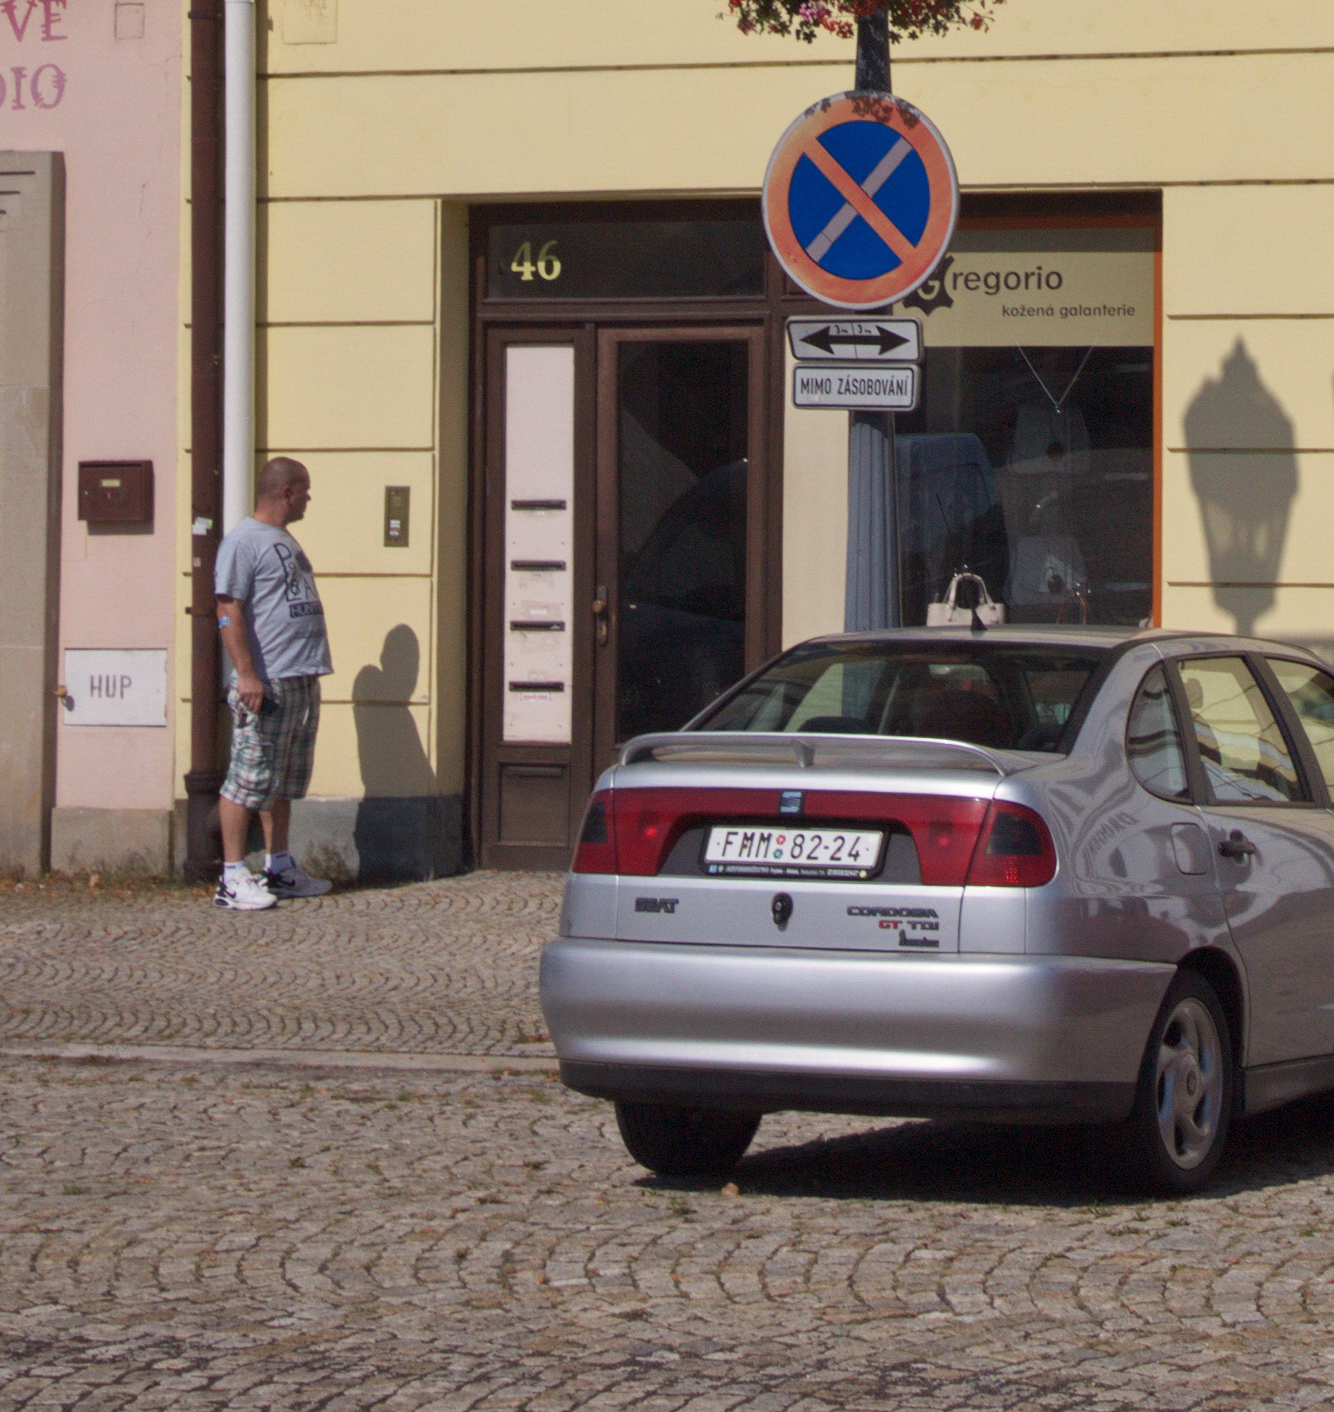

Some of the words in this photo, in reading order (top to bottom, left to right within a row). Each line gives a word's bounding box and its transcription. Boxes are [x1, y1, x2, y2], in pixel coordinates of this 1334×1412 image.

[0, 63, 67, 110] IO
[511, 240, 562, 280] 46
[1002, 304, 1054, 317] kožená
[1060, 304, 1135, 318] galanterie
[801, 378, 831, 395] MIMO
[838, 374, 909, 396] ZÁSOBOVÁNÍ
[90, 675, 132, 699] HUP
[722, 831, 772, 859] FMM
[790, 833, 862, 862] 82-24
[635, 897, 679, 914] SEAT
[878, 919, 903, 929] GT
[906, 920, 940, 931] TDI
